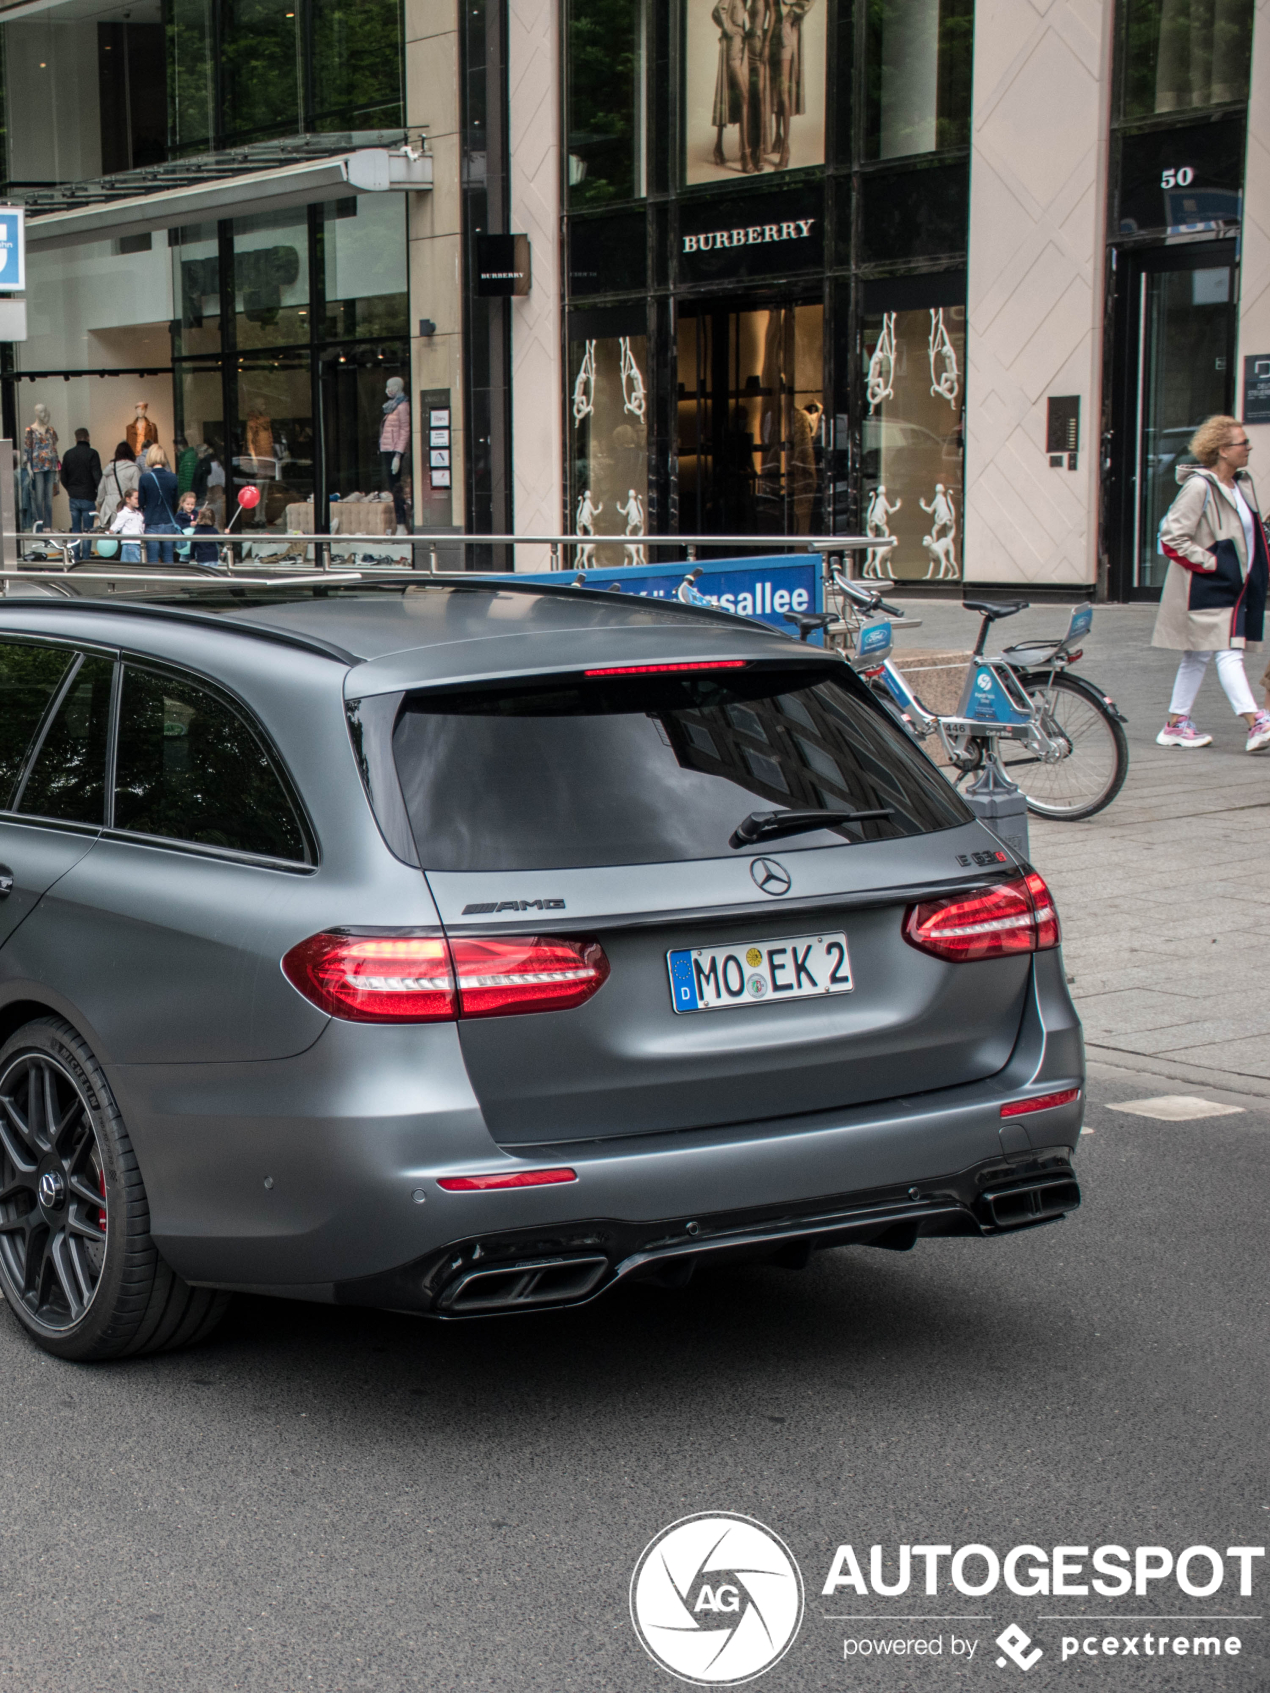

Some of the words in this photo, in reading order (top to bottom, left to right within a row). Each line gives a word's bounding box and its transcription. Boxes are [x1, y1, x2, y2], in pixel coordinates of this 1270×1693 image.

[1161, 166, 1194, 189] 50
[683, 219, 815, 253] BURBERRY
[945, 724, 966, 733] 446
[955, 854, 971, 867] E
[496, 898, 566, 912] AMG
[693, 954, 745, 1001] MO
[766, 944, 818, 993] EK
[825, 941, 849, 985] 2
[681, 987, 690, 1000] D
[60, 1046, 99, 1108] MICHELIN
